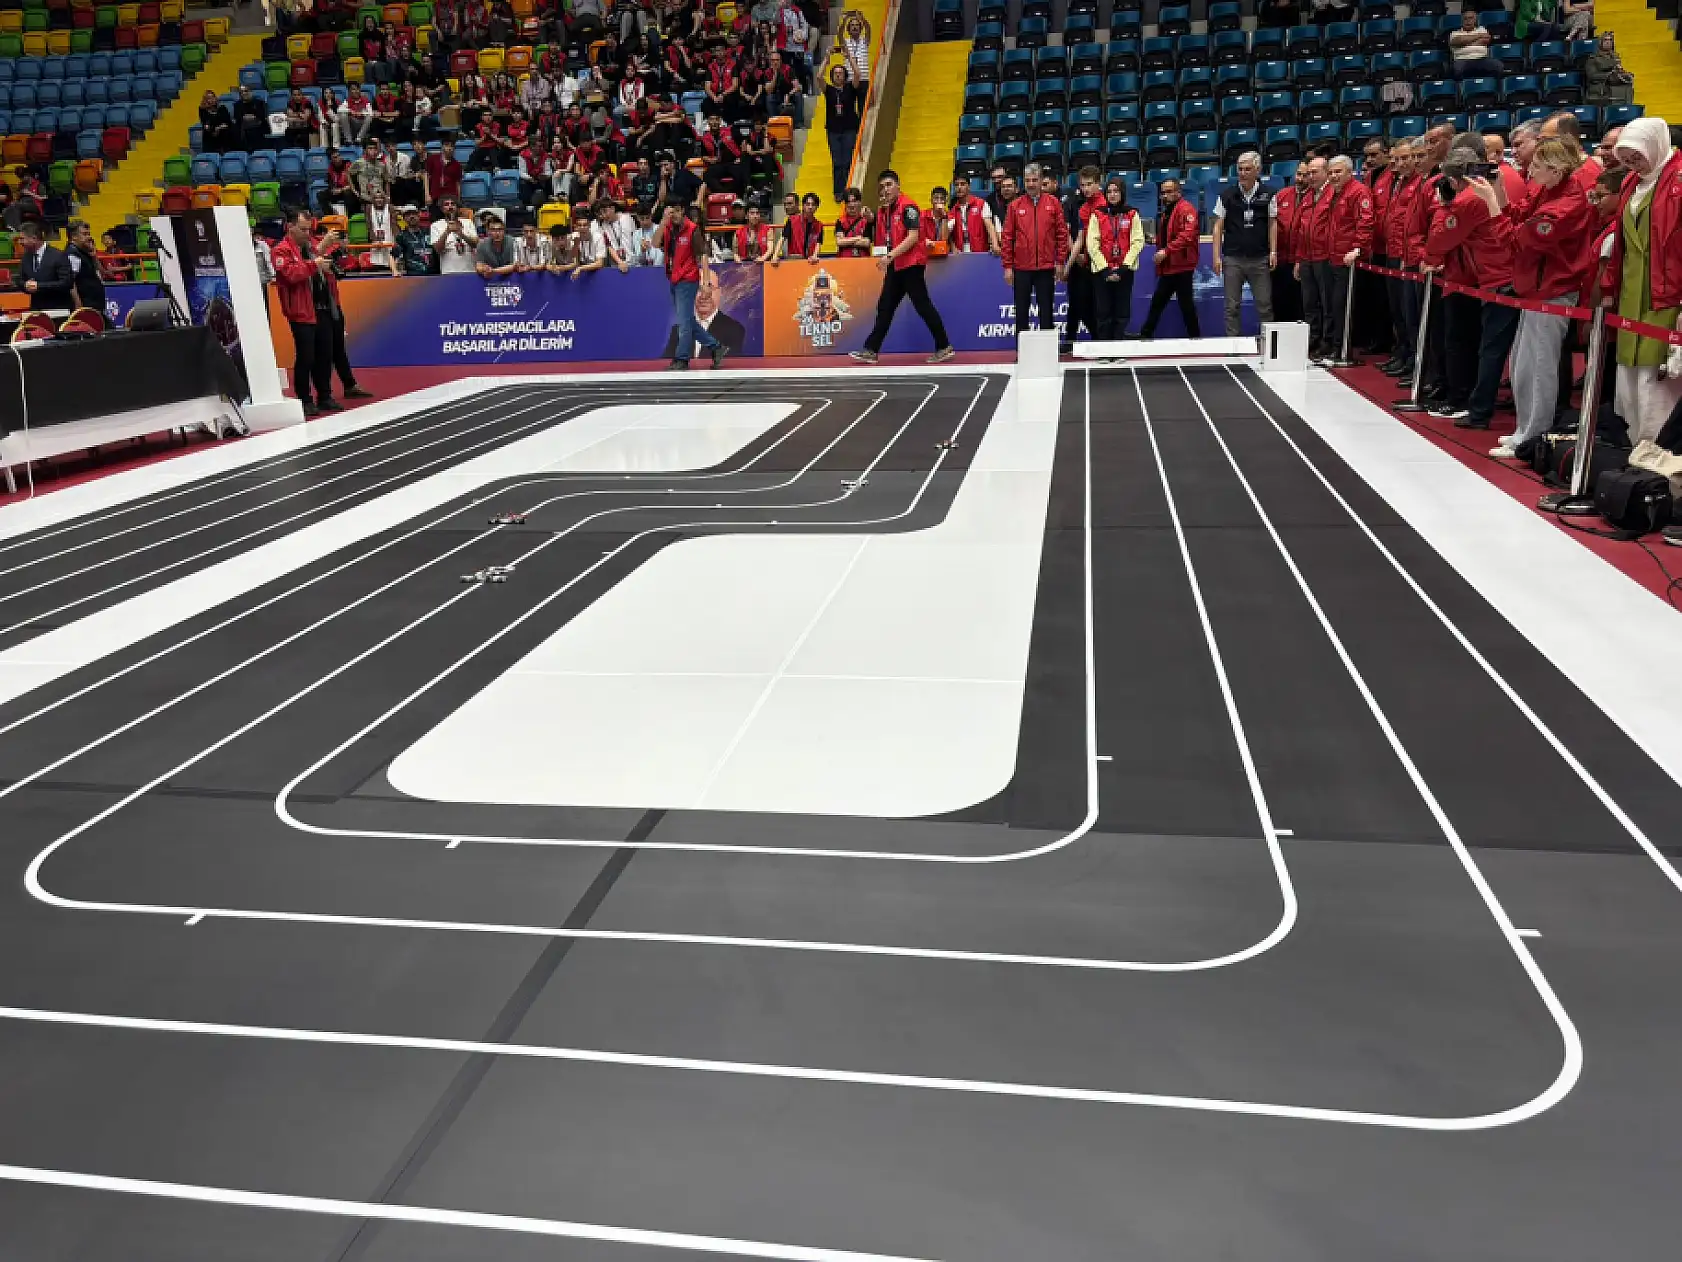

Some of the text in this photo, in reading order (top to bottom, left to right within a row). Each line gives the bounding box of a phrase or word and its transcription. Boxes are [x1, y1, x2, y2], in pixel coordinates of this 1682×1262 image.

[439, 319, 576, 337] TÜM YARIŞMACILARA
[442, 335, 573, 355] BAŞARILAR DİLERİM
